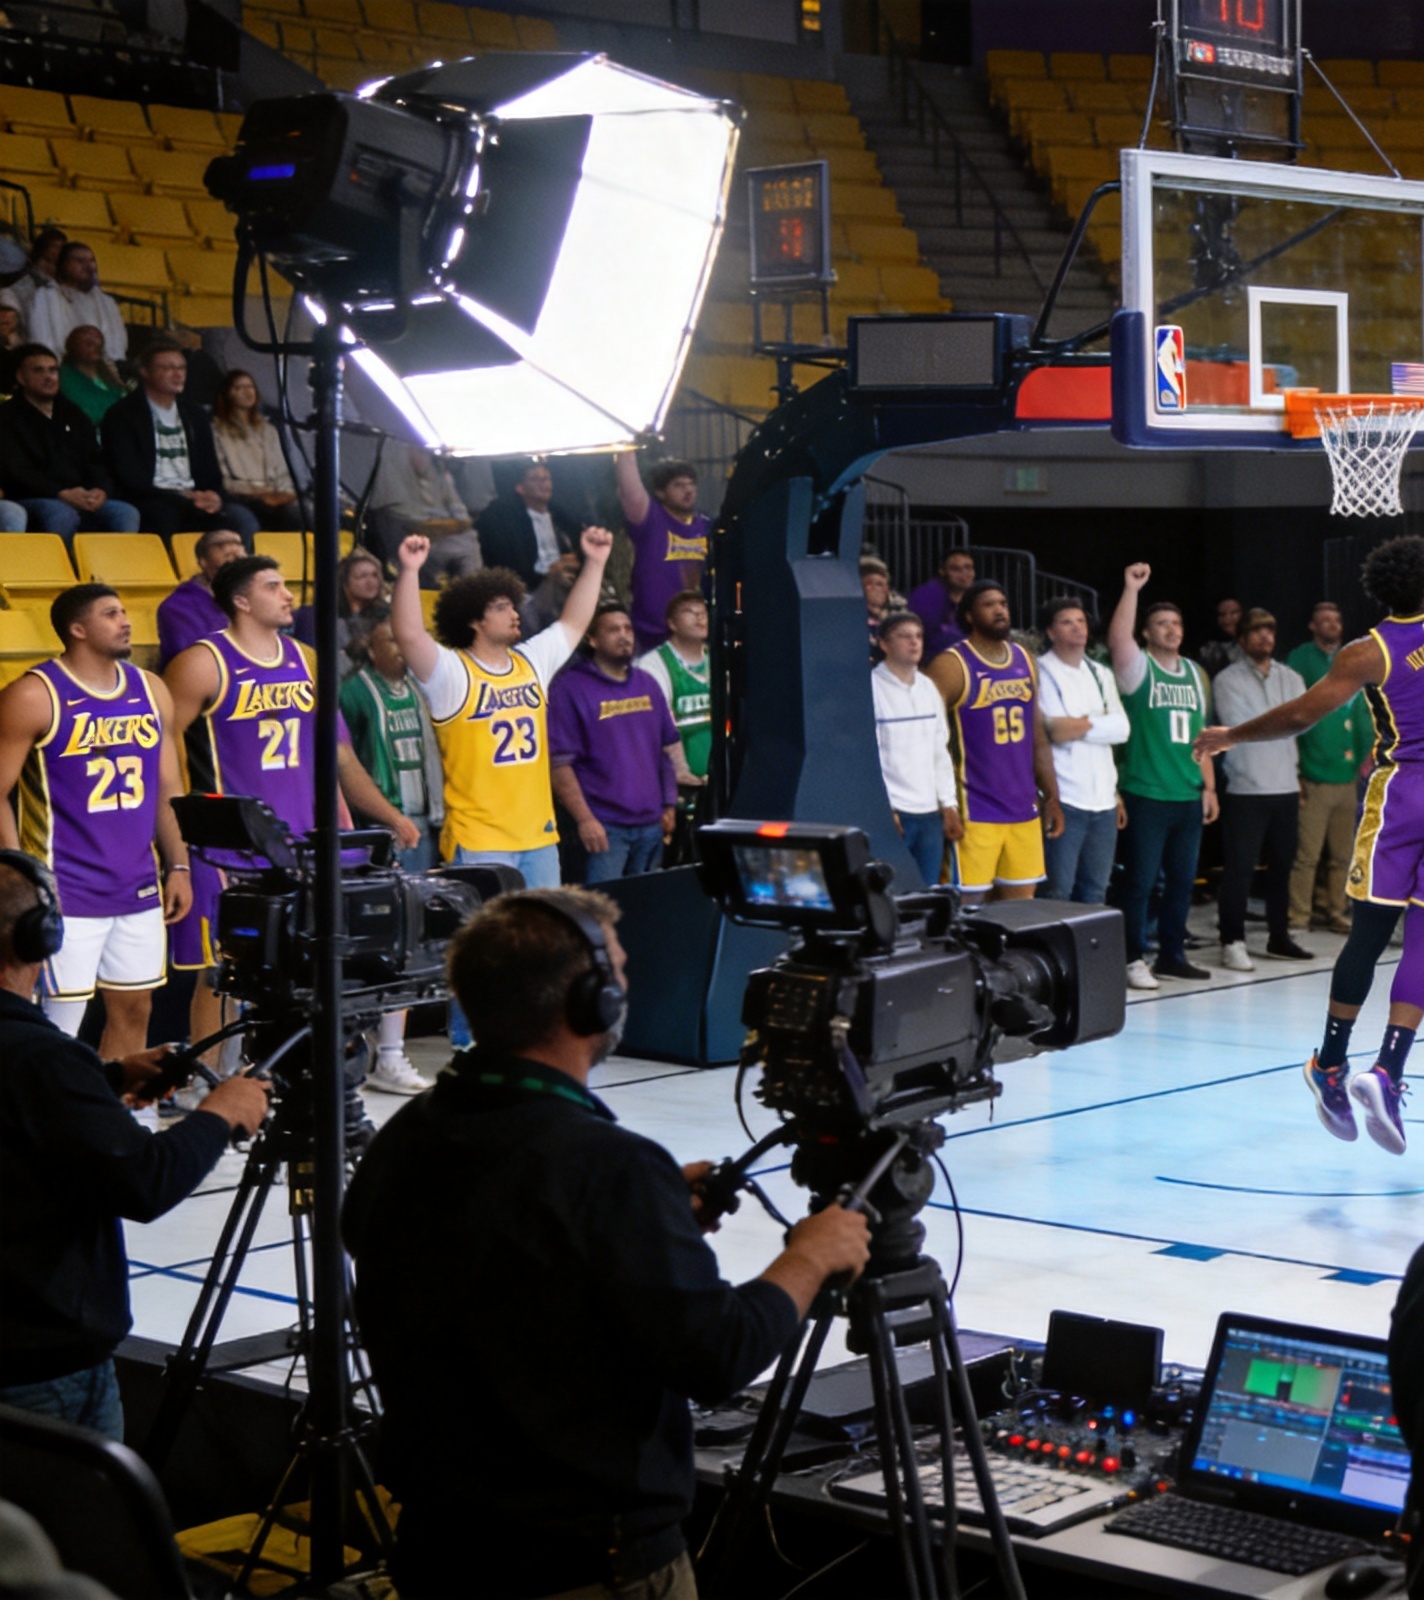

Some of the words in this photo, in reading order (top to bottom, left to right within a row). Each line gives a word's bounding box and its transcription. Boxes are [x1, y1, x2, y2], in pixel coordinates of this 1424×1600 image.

[59, 712, 159, 757] LAKERS
[258, 717, 301, 770] 21
[491, 715, 538, 764] 23
[86, 755, 145, 813] 23
